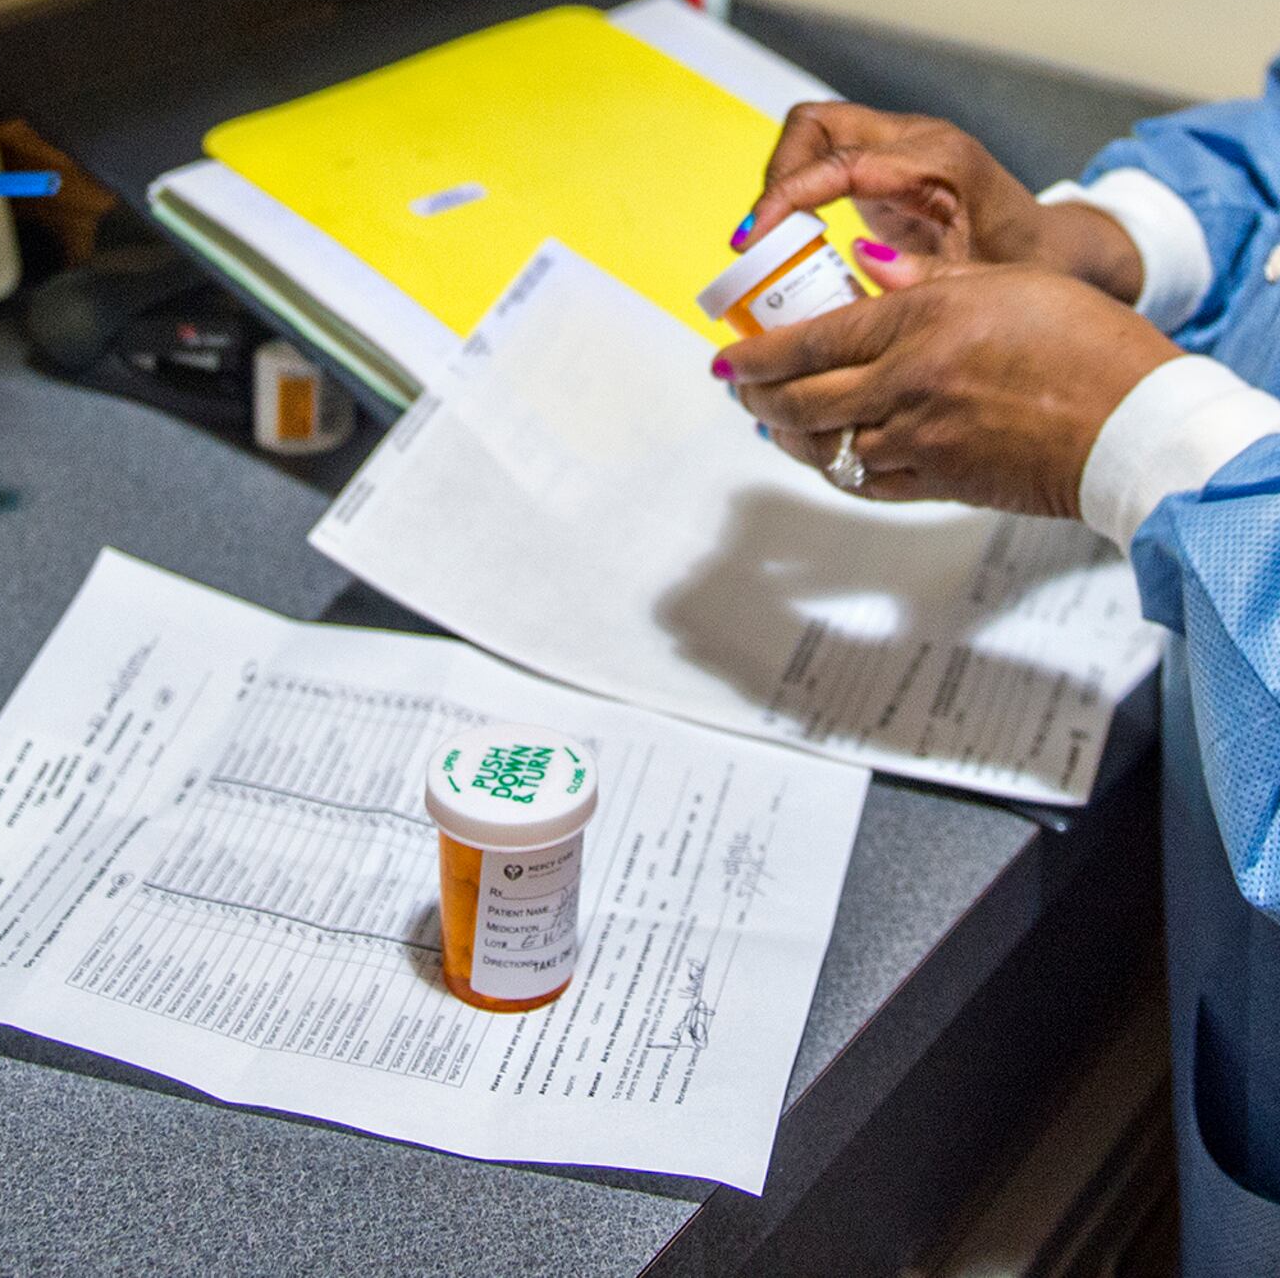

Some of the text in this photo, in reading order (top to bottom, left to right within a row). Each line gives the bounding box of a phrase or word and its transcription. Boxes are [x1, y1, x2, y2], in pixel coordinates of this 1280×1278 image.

[443, 748, 462, 772] OPEN
[472, 746, 509, 790] PUSH
[490, 744, 532, 799] DOWN
[512, 746, 555, 804] & TURN
[566, 767, 586, 795] CLOSE
[489, 887, 502, 898] Rx
[488, 905, 548, 918] PATIENT NAME
[486, 921, 539, 934] MEDICATION
[533, 956, 558, 973] TAKE
[502, 1045, 513, 1059] had
[497, 1059, 508, 1073] you
[489, 1073, 502, 1092] Have
[537, 1082, 549, 1094] Are
[544, 1067, 555, 1082] you
